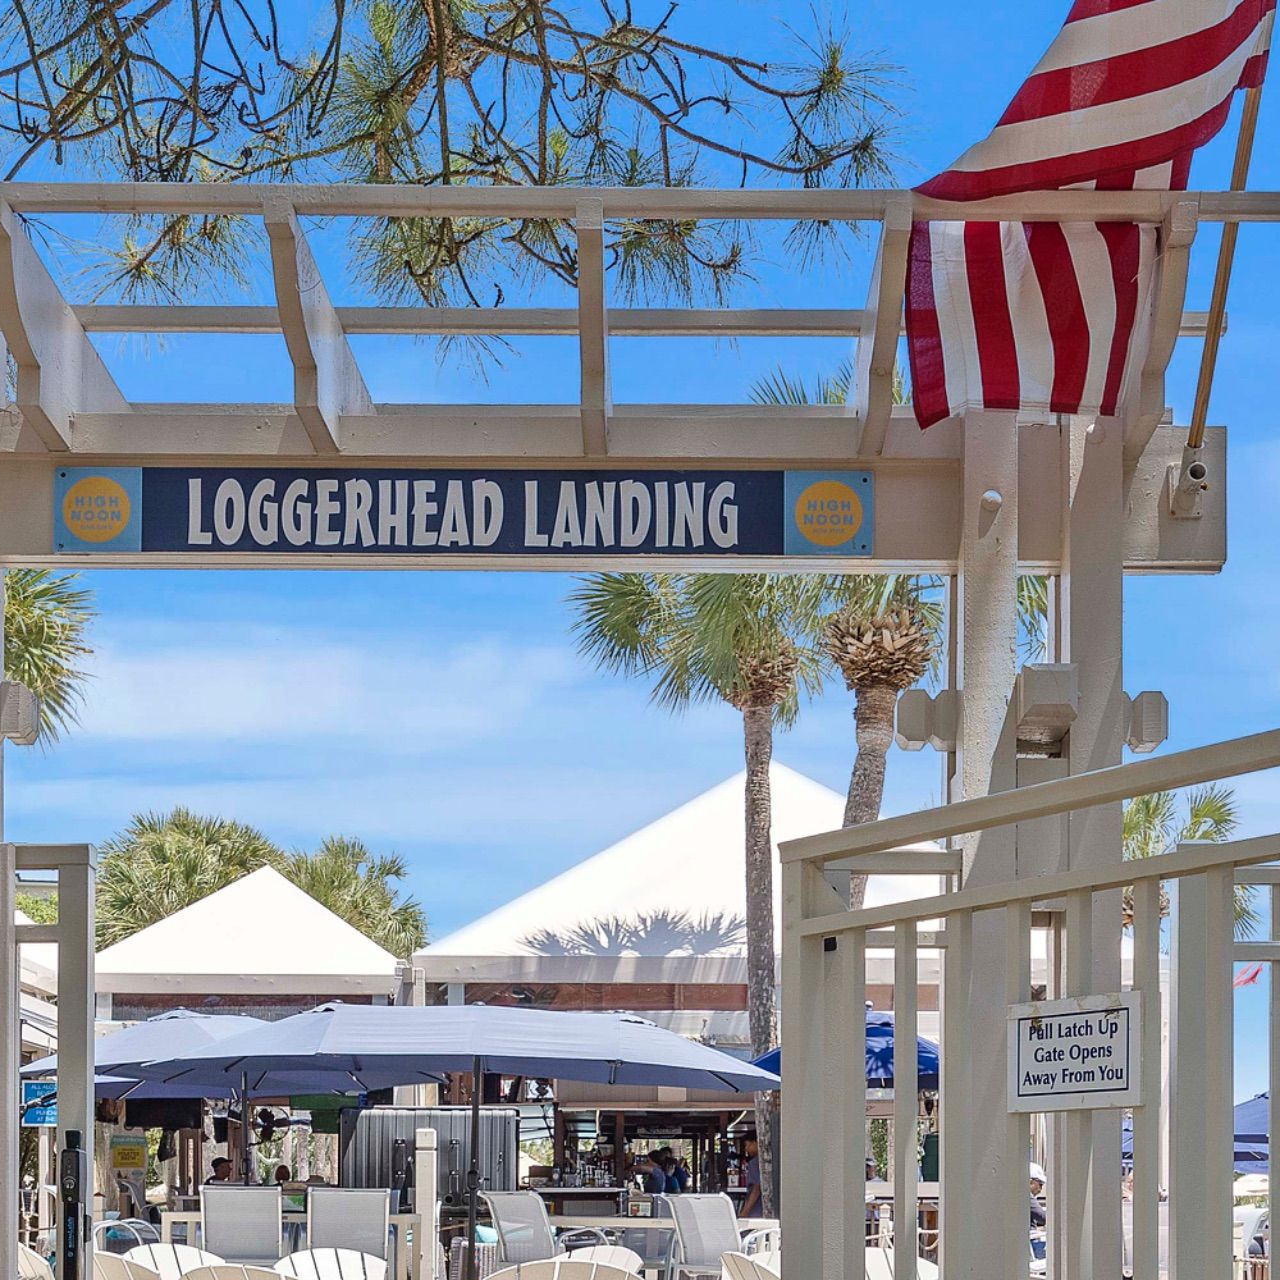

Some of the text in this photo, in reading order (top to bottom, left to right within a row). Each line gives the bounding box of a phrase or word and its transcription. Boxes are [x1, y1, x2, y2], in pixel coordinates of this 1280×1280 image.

[74, 495, 119, 507] HIGH
[807, 499, 851, 512] HIGH
[70, 509, 122, 521] NOON
[186, 478, 739, 549] LOGGERHEAD LANDING
[803, 513, 854, 526] NOON
[1058, 1019, 1093, 1039] Latch
[1098, 1018, 1119, 1039] Up
[1033, 1044, 1113, 1064] Gate Opens
[1022, 1065, 1124, 1090] Away From You
